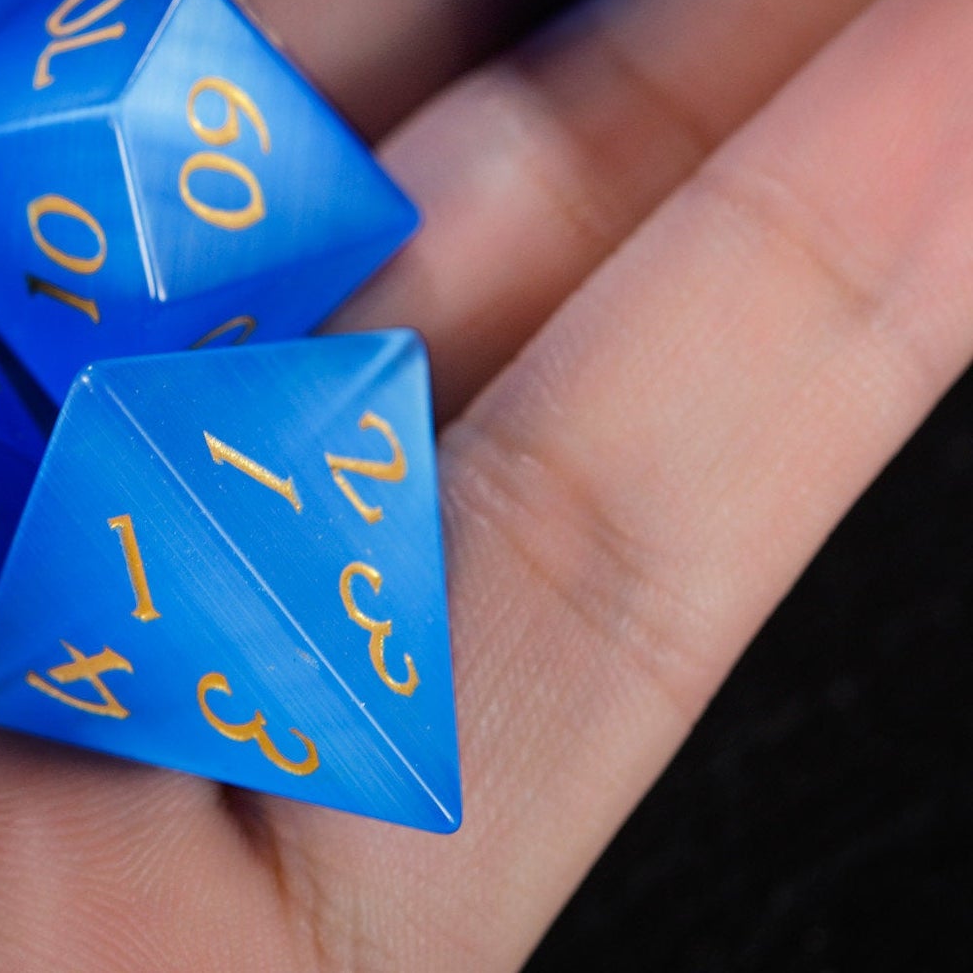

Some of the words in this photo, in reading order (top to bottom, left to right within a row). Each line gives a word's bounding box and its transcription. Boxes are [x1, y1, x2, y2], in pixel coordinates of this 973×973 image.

[25, 193, 108, 324] 10
[201, 429, 303, 515] 1
[324, 409, 408, 525] 2
[105, 513, 163, 623] 1
[26, 638, 135, 720] 4
[337, 560, 421, 698] 3
[195, 670, 322, 777] 3
